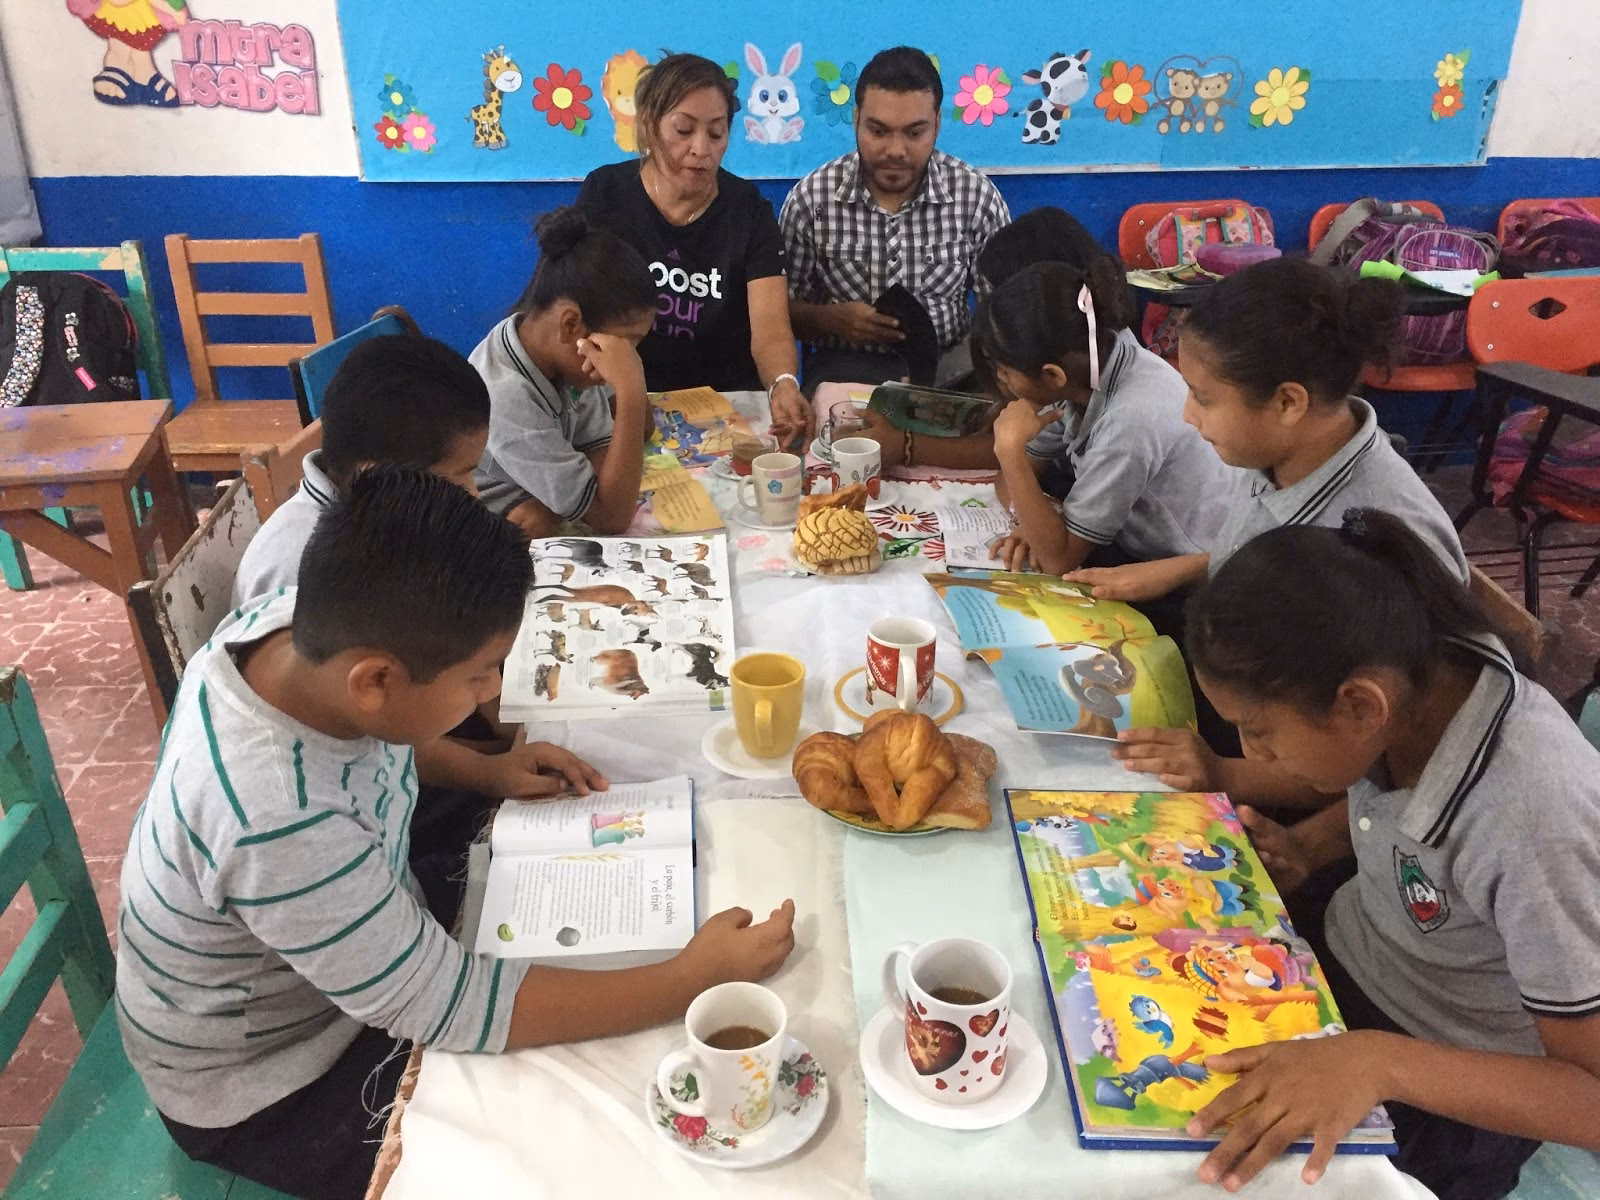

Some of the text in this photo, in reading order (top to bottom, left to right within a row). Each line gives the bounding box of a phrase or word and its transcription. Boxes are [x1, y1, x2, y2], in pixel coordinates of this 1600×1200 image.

[171, 60, 320, 115] Isabel
[648, 261, 722, 299] oost
[657, 293, 704, 323] our
